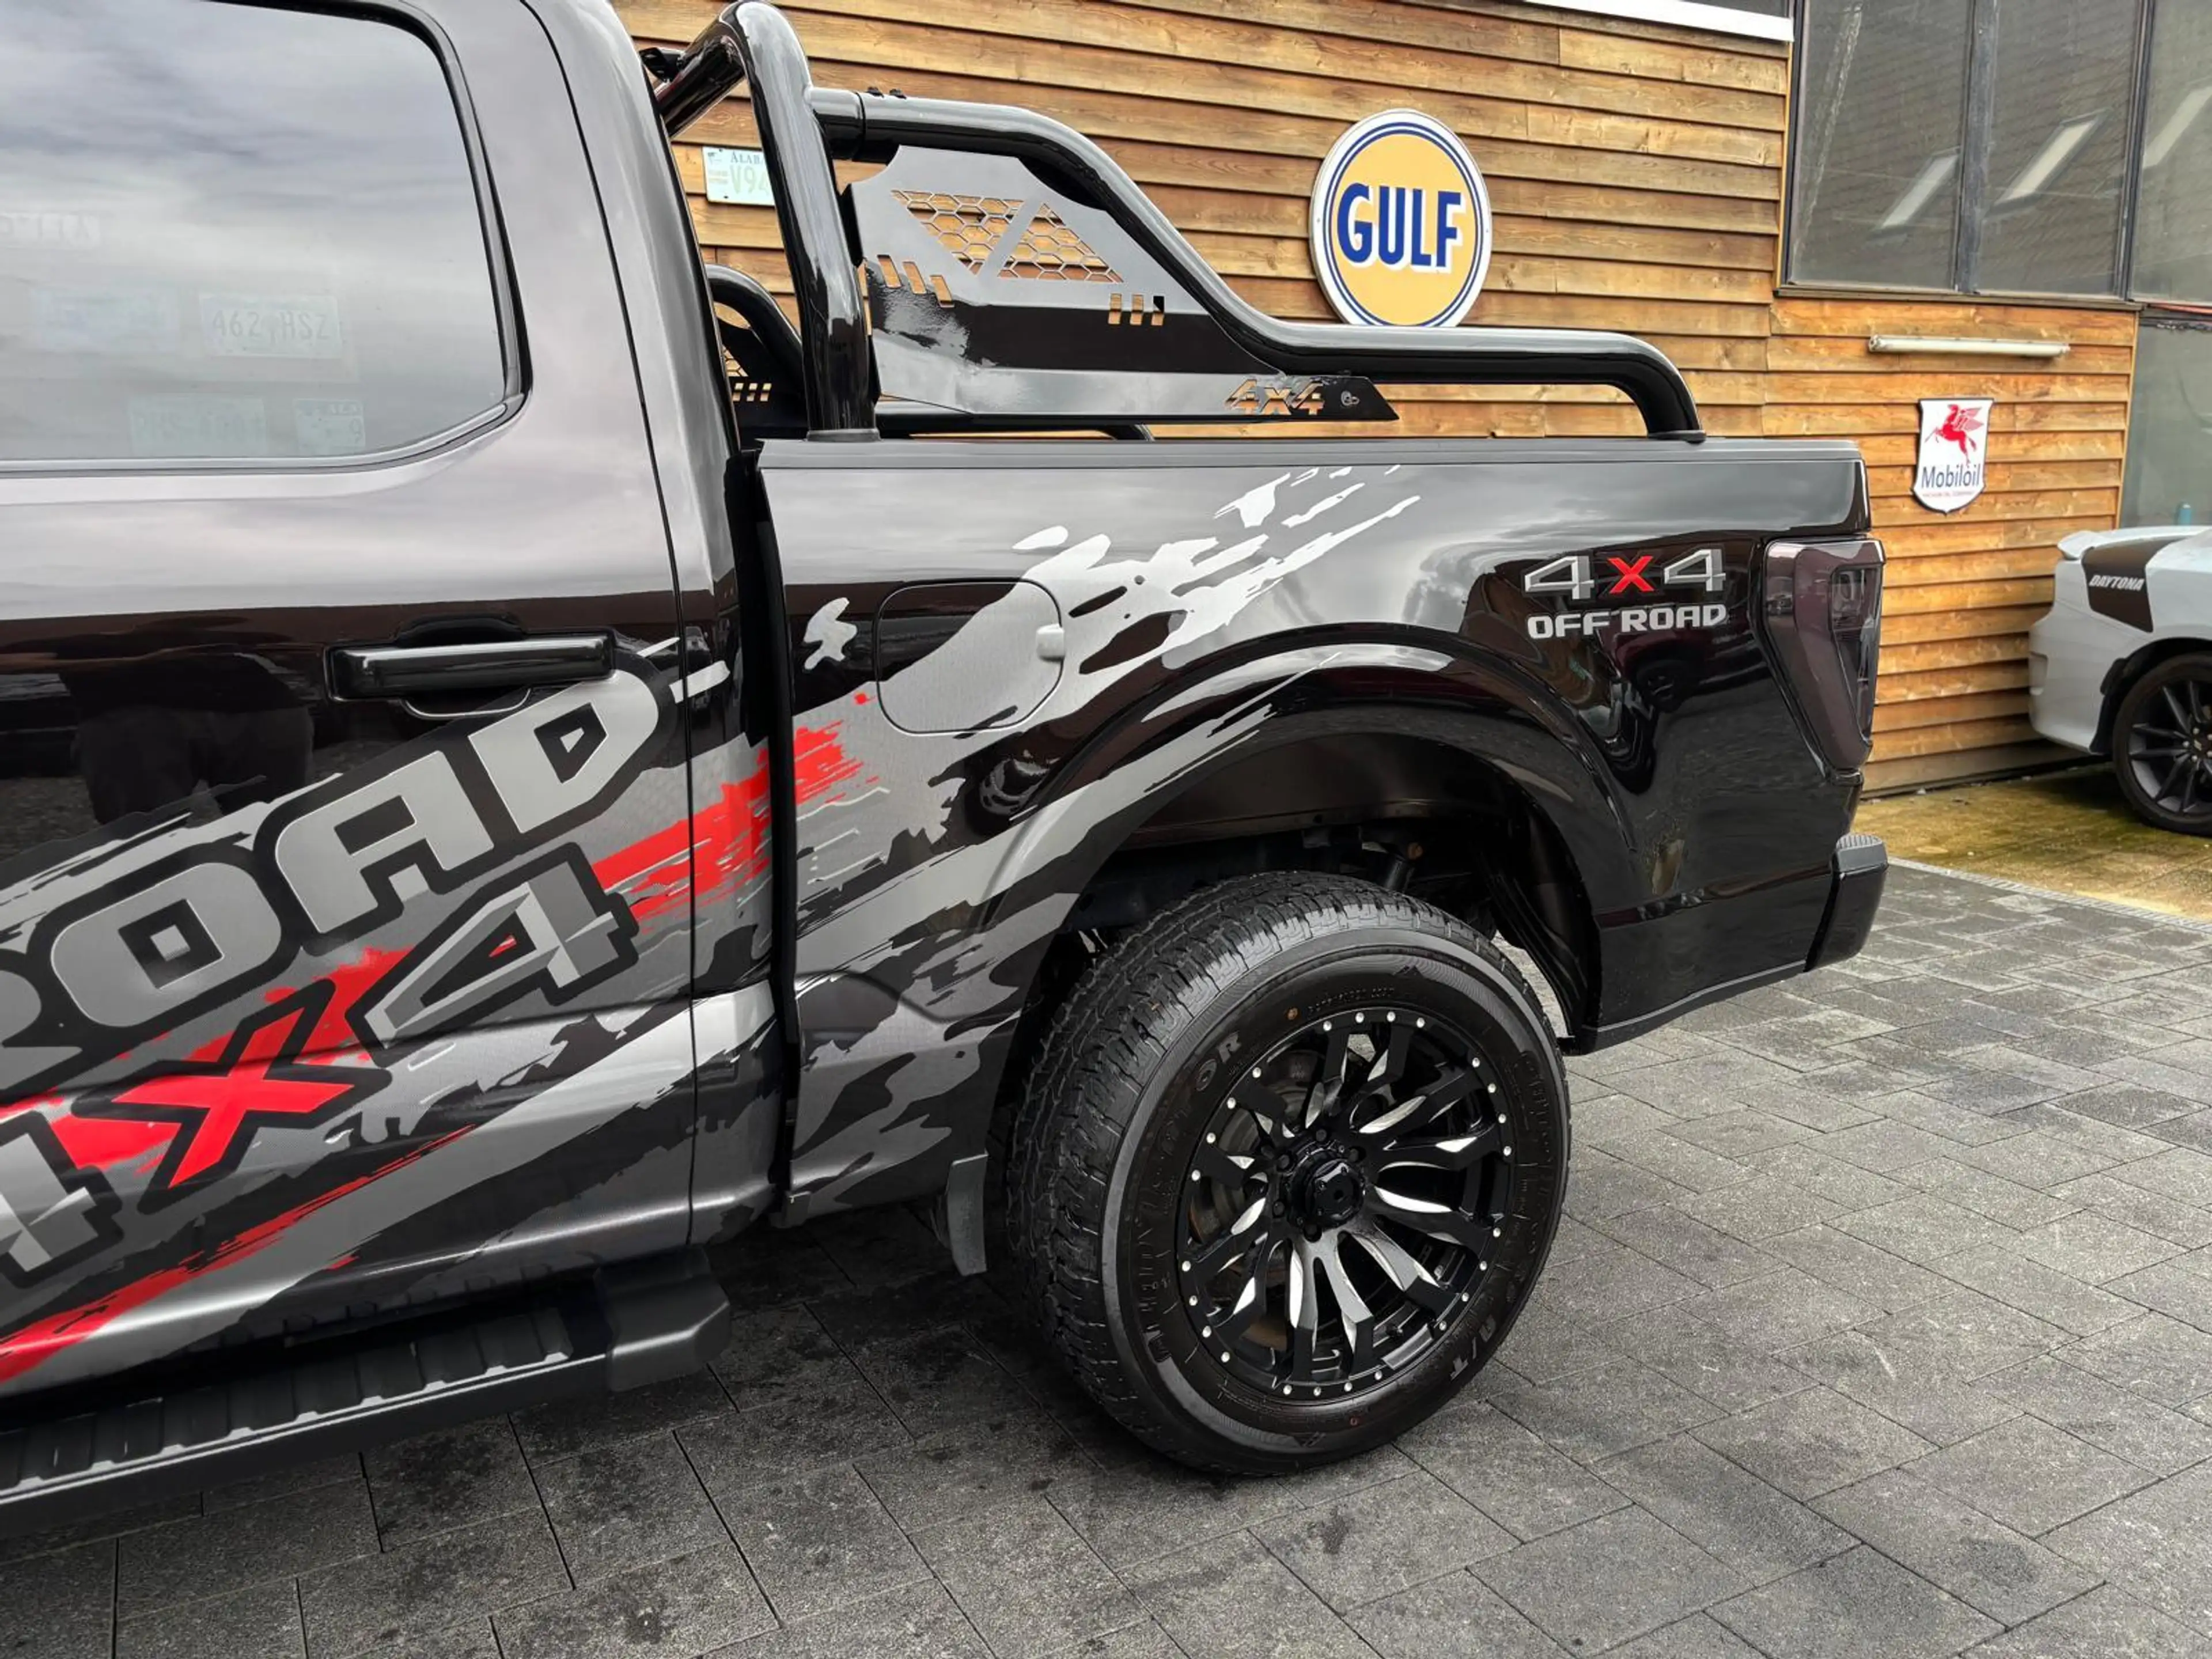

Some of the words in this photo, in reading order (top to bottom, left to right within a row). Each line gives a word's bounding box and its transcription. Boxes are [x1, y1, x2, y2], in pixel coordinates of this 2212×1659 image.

[730, 150, 765, 165] ALAB
[1337, 182, 1463, 270] GULF
[213, 309, 262, 338] 462
[1921, 463, 1981, 488] Mobiloil
[2089, 575, 2145, 591] DAYTONA
[1527, 611, 1611, 639] OFF
[1621, 603, 1728, 633] ROAD
